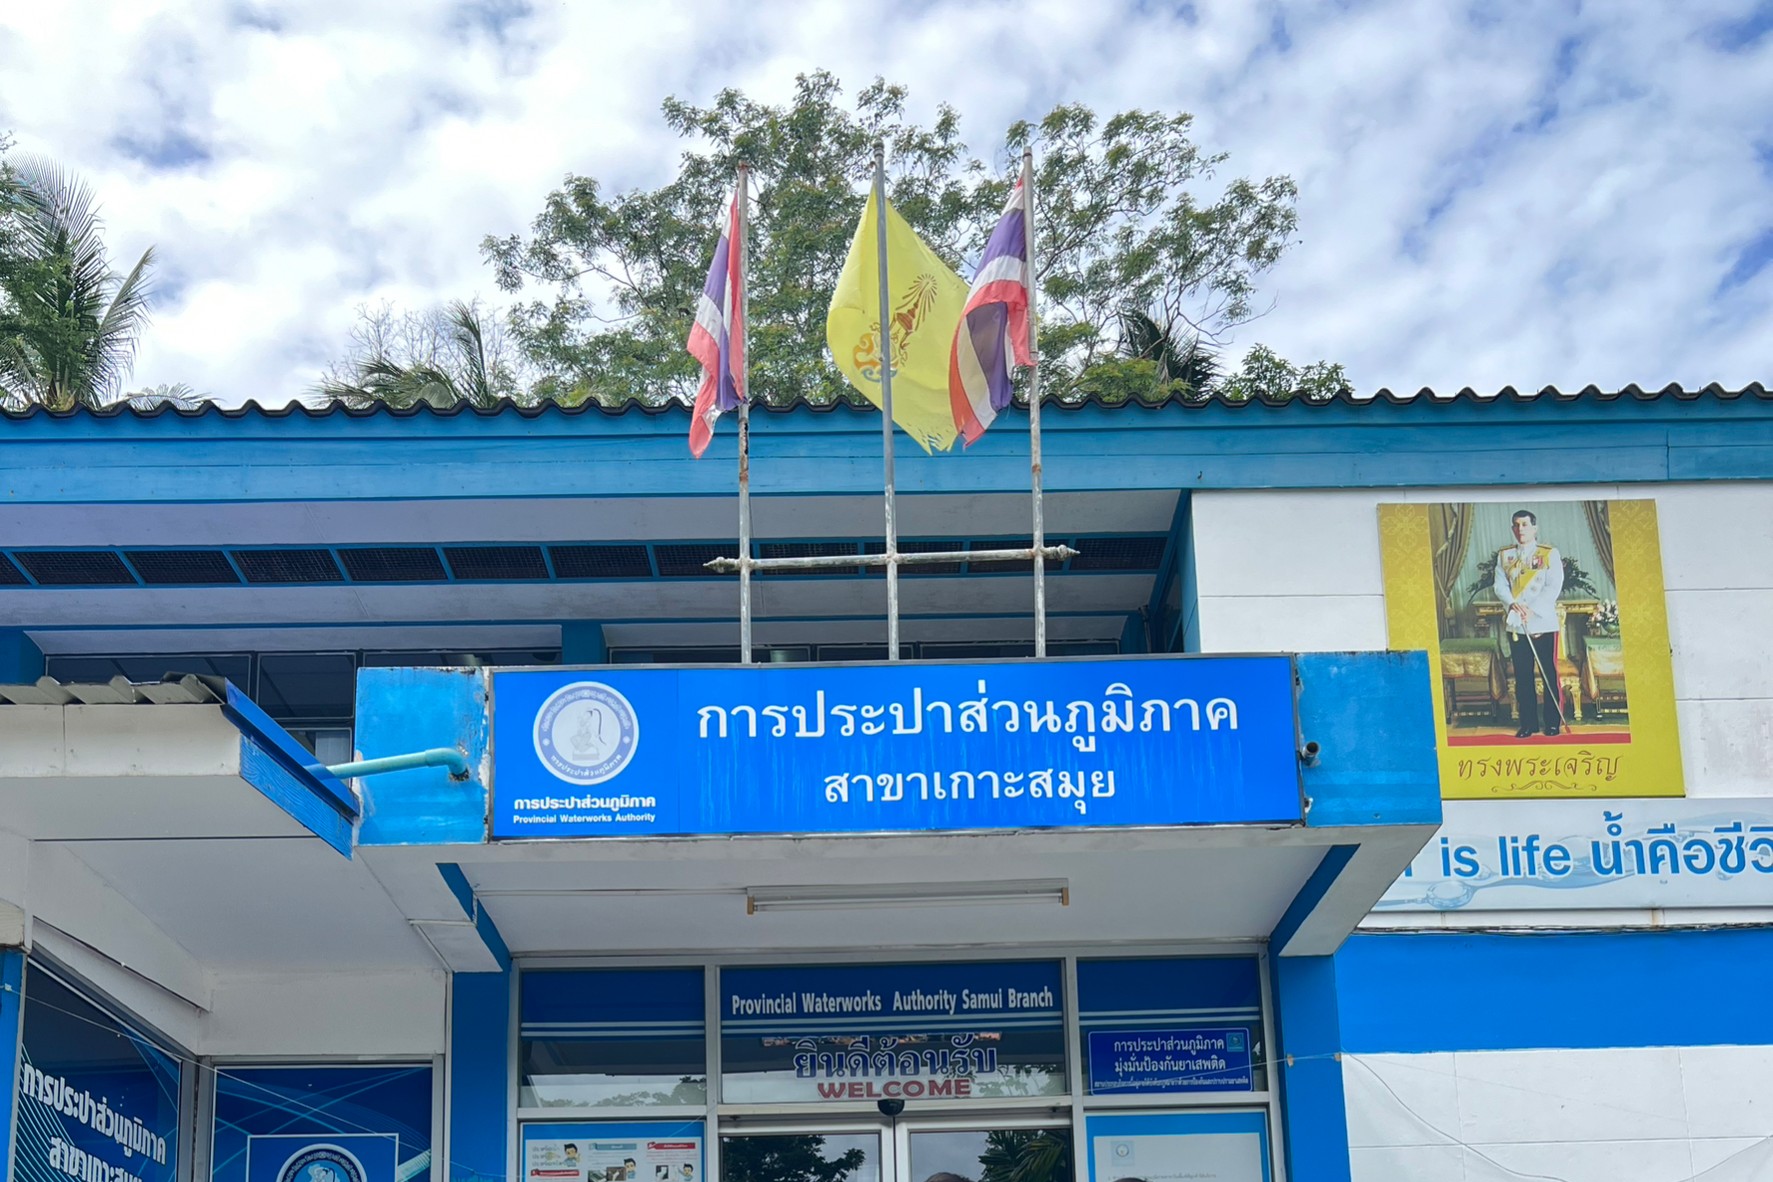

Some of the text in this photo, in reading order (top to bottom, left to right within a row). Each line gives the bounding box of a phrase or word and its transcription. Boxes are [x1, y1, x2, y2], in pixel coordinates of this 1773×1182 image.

[698, 679, 1239, 752] การประปาส่วนภูมิภาค
[1458, 750, 1625, 782] ทรงพระเจริญ
[514, 794, 656, 811] การประปาส่วนภูมิภาค
[824, 766, 1116, 814] สาขาเกาะสมุย
[513, 812, 656, 824] Provincial Waterworks Authority
[1440, 837, 1480, 877] is
[1498, 834, 1572, 877] life
[732, 986, 1053, 1015] Provincial Waterworks Authority Samui Branch
[794, 1033, 997, 1079] ยินดีต้อนรับ
[1114, 1035, 1225, 1055] การประปาส่วนภูมิภาค
[1114, 1055, 1226, 1077] มุ่งมั่นป้องกันยาเสพติด
[817, 1079, 971, 1099] WELCOME
[23, 1062, 166, 1166] การประปาส่วนภูมิภาค
